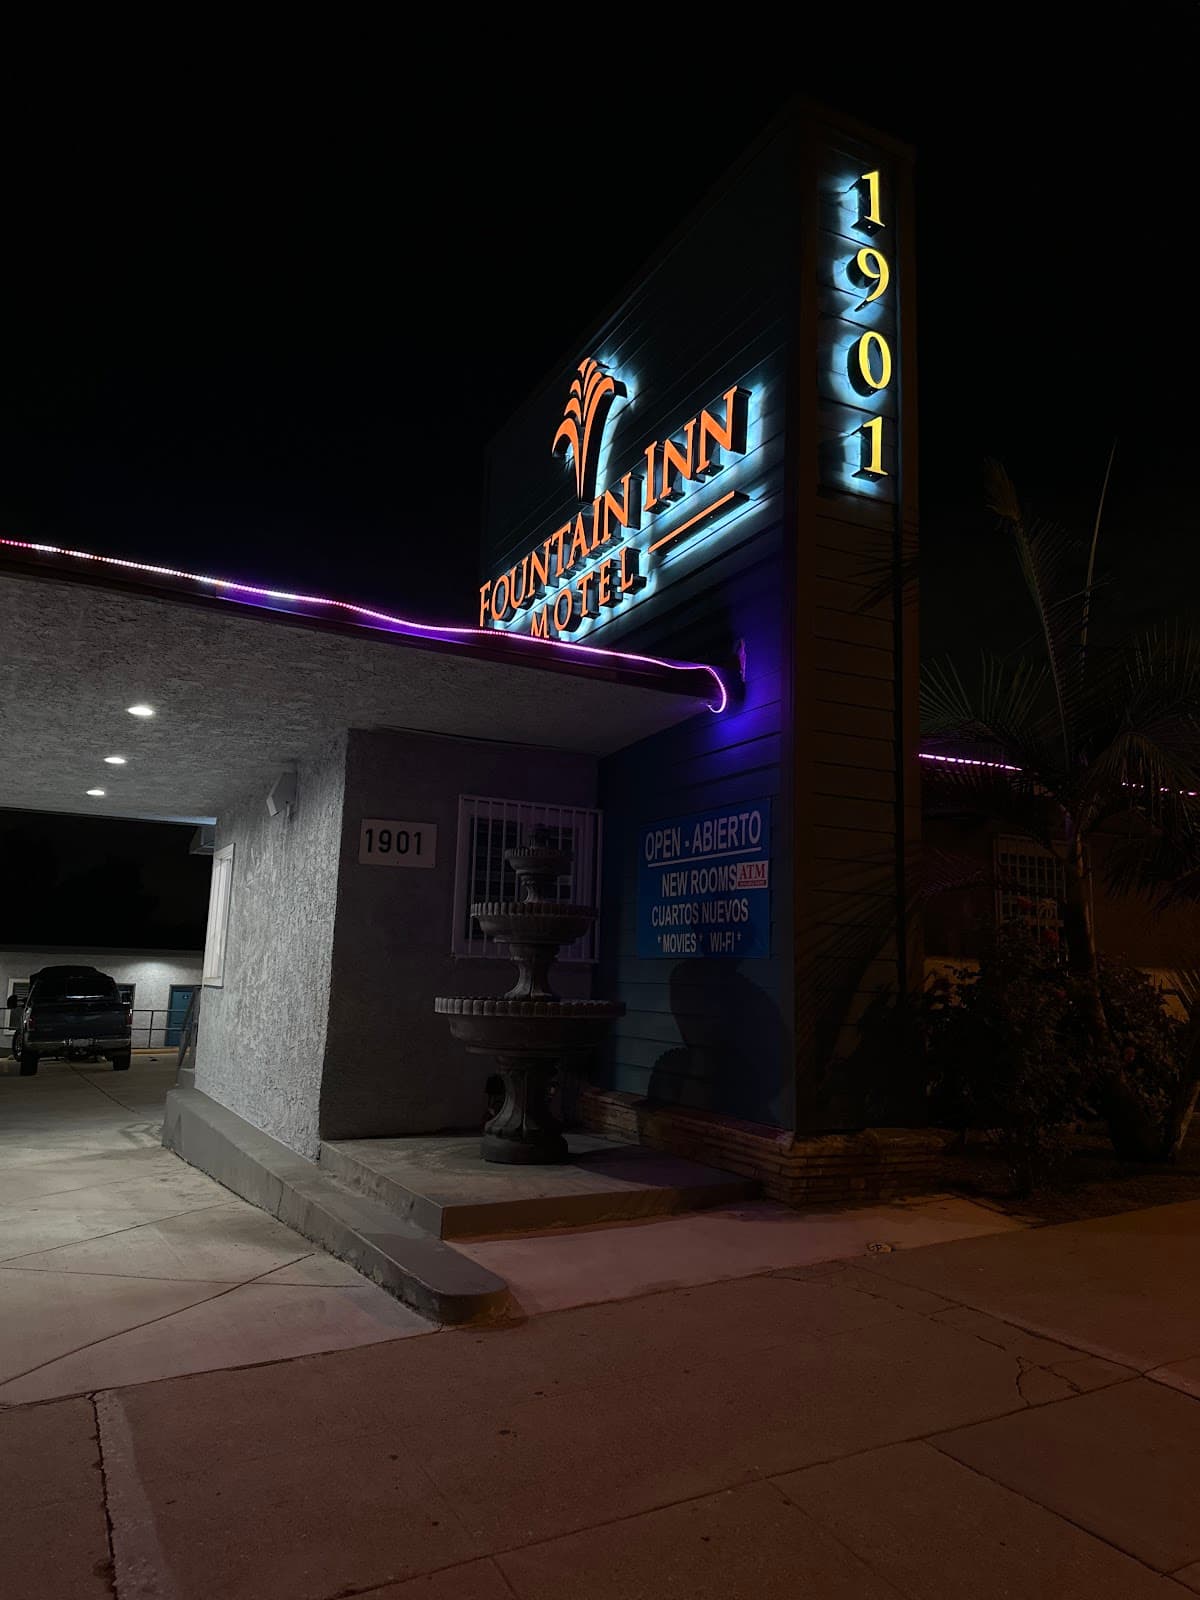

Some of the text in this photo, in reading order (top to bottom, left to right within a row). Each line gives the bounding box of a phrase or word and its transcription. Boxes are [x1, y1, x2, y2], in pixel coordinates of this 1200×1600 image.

[857, 169, 892, 478] 1901
[479, 385, 739, 628] FOUNTAIN INN
[531, 546, 635, 640] MOTEL
[365, 829, 421, 855] 1901
[645, 826, 681, 861] OPEN
[691, 810, 762, 854] ABIERTO
[661, 864, 737, 898] NEW ROOMS
[739, 863, 766, 880] ATM
[651, 897, 749, 927] CUARTOS NUEVOS
